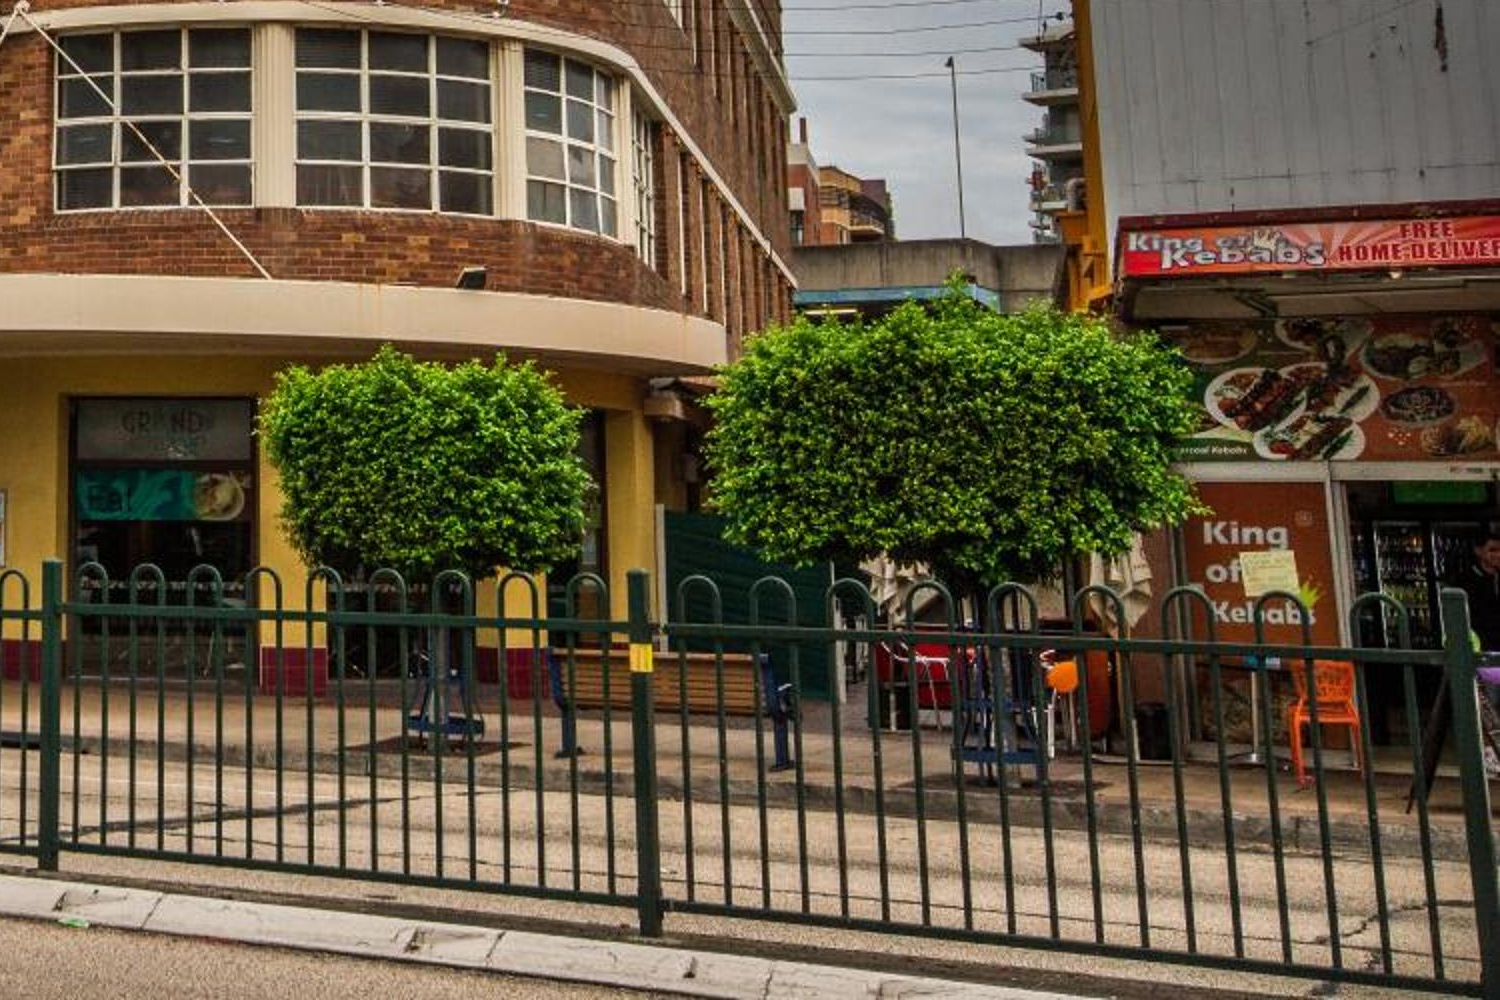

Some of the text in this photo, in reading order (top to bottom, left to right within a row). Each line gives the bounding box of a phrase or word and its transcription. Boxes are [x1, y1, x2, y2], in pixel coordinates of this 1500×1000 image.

[1128, 230, 1205, 254] King
[1400, 221, 1453, 239] FREE
[1159, 237, 1326, 270] Kebabs
[1337, 244, 1401, 261] HOME
[122, 408, 206, 434] GRND
[1203, 520, 1288, 552] King
[1205, 557, 1242, 583] of
[1213, 600, 1317, 625] Kebabs
